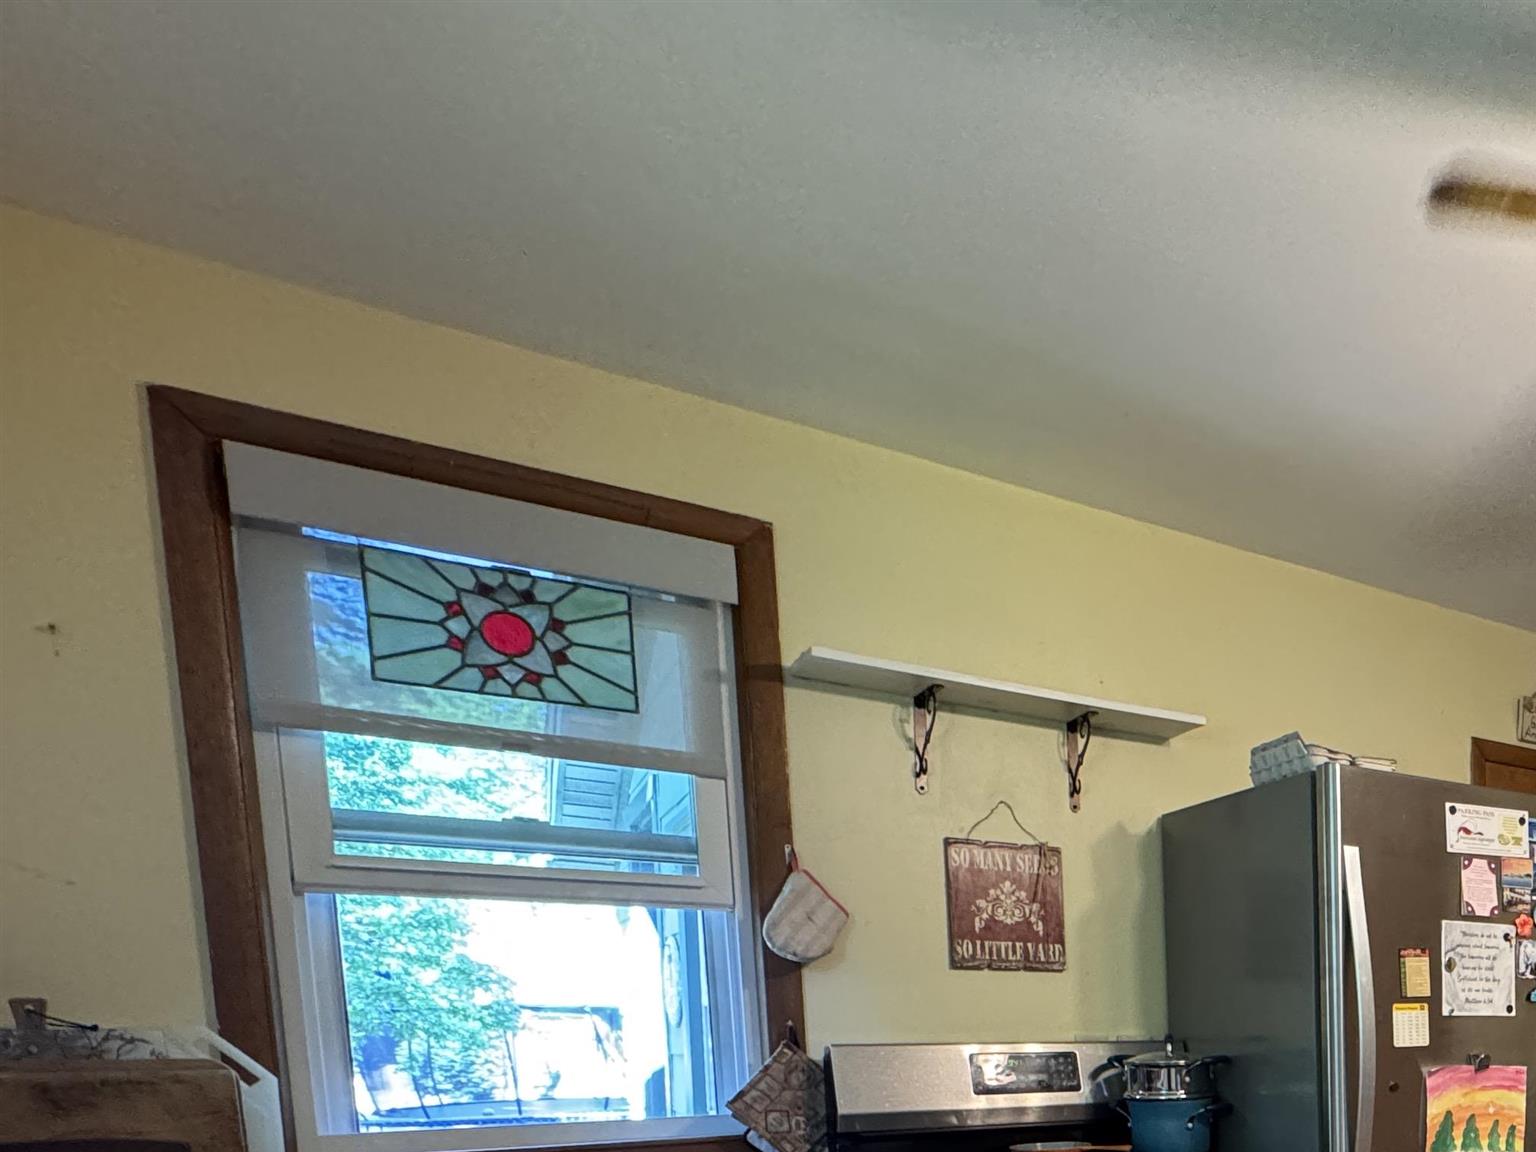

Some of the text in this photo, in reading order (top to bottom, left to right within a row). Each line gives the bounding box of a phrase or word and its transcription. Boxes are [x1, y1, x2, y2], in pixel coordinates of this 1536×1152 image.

[951, 847, 970, 867] SO
[974, 850, 1013, 871] MANY
[956, 938, 973, 959] SO
[976, 940, 1024, 960] LITTLE
